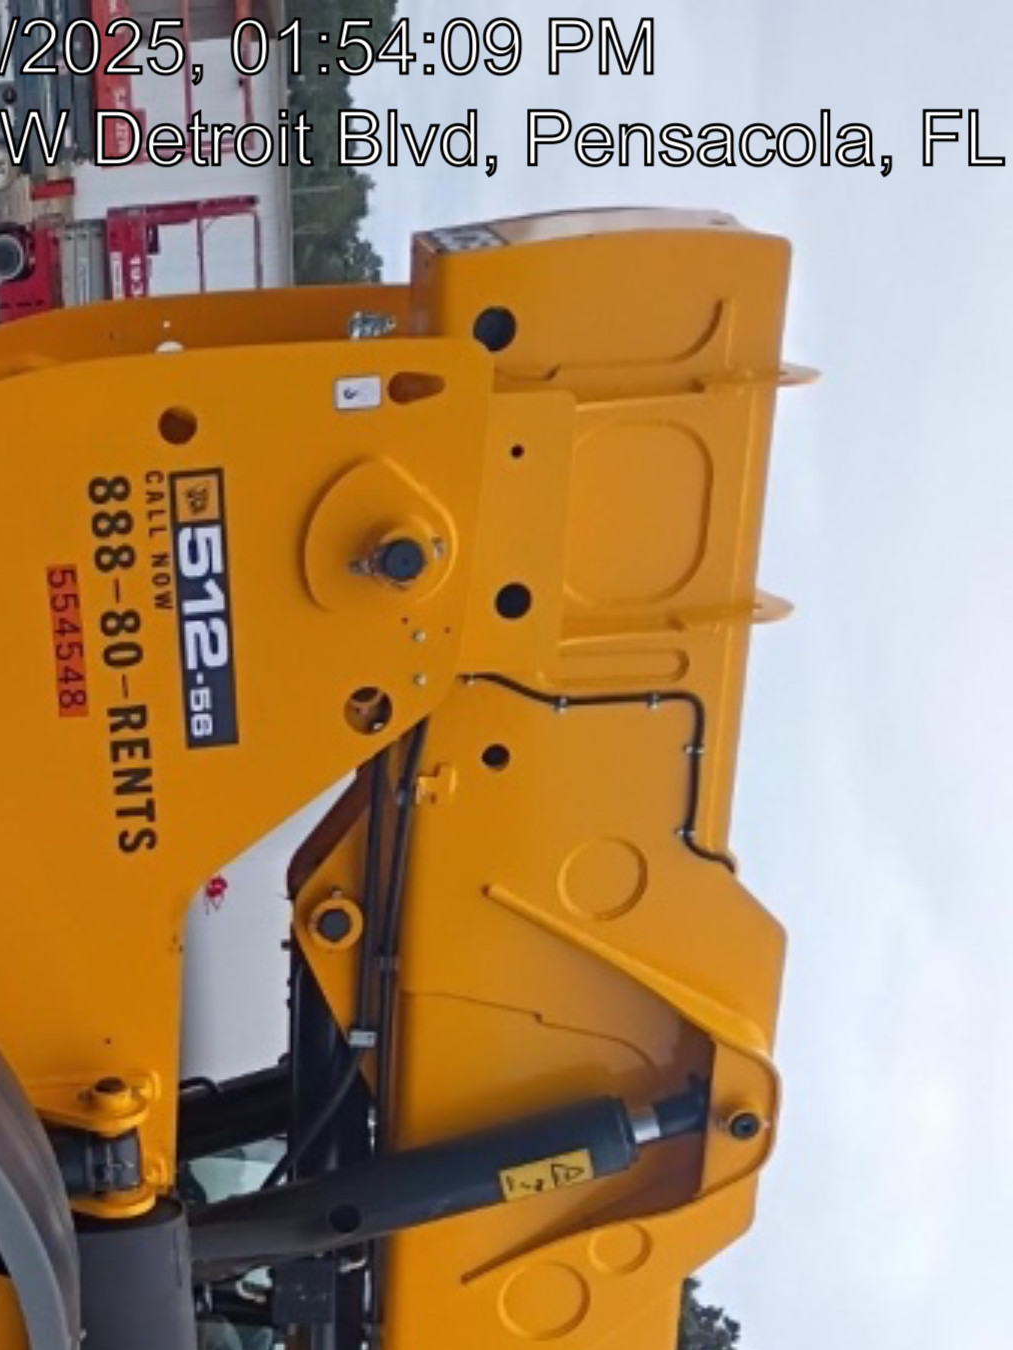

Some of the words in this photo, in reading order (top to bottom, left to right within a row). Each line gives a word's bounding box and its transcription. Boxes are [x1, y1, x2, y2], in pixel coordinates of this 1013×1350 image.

[144, 470, 166, 539] CALL
[46, 567, 88, 712] 554548
[150, 551, 173, 612] NOW
[177, 525, 229, 738] 512-56
[88, 475, 158, 855] 888-80-RENTS
